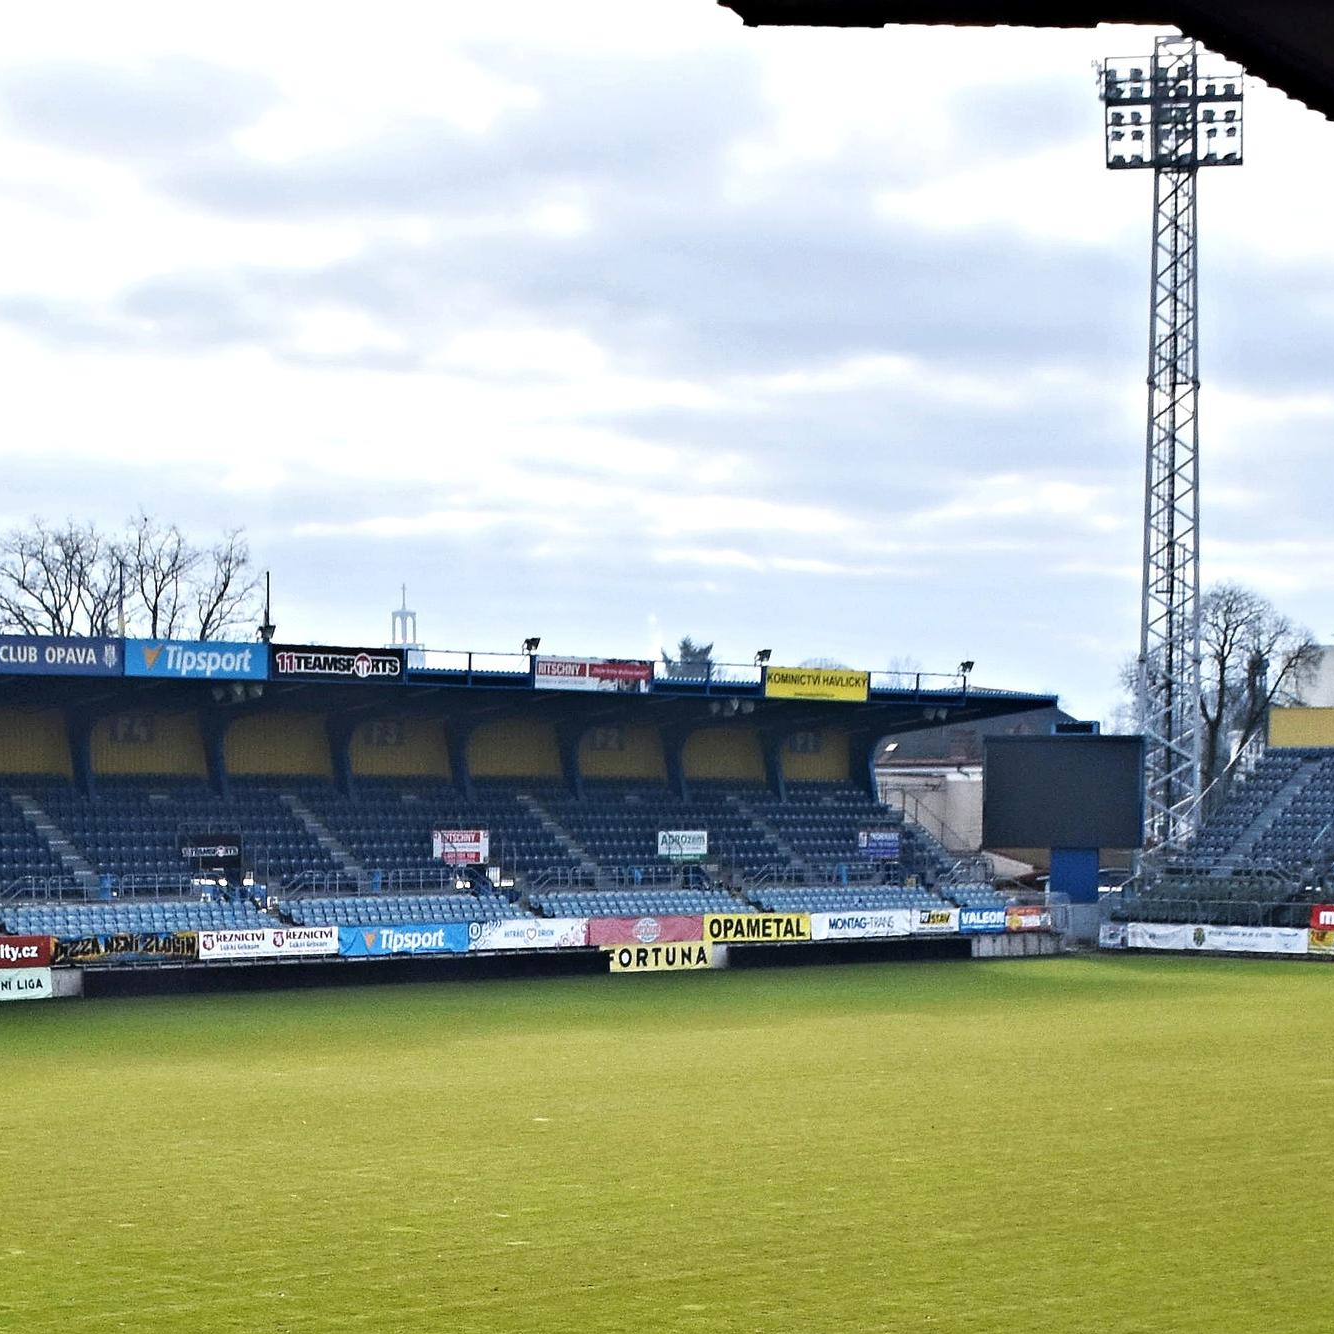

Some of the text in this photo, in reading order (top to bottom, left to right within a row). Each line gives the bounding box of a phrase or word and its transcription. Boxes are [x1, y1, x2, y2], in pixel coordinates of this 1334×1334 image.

[0, 644, 38, 663] CLUB
[45, 646, 97, 665] OPAVA
[166, 645, 251, 676] Tipsport
[709, 917, 805, 938] OPAMETAL
[380, 929, 444, 949] Tipsport
[17, 978, 43, 990] LIGA
